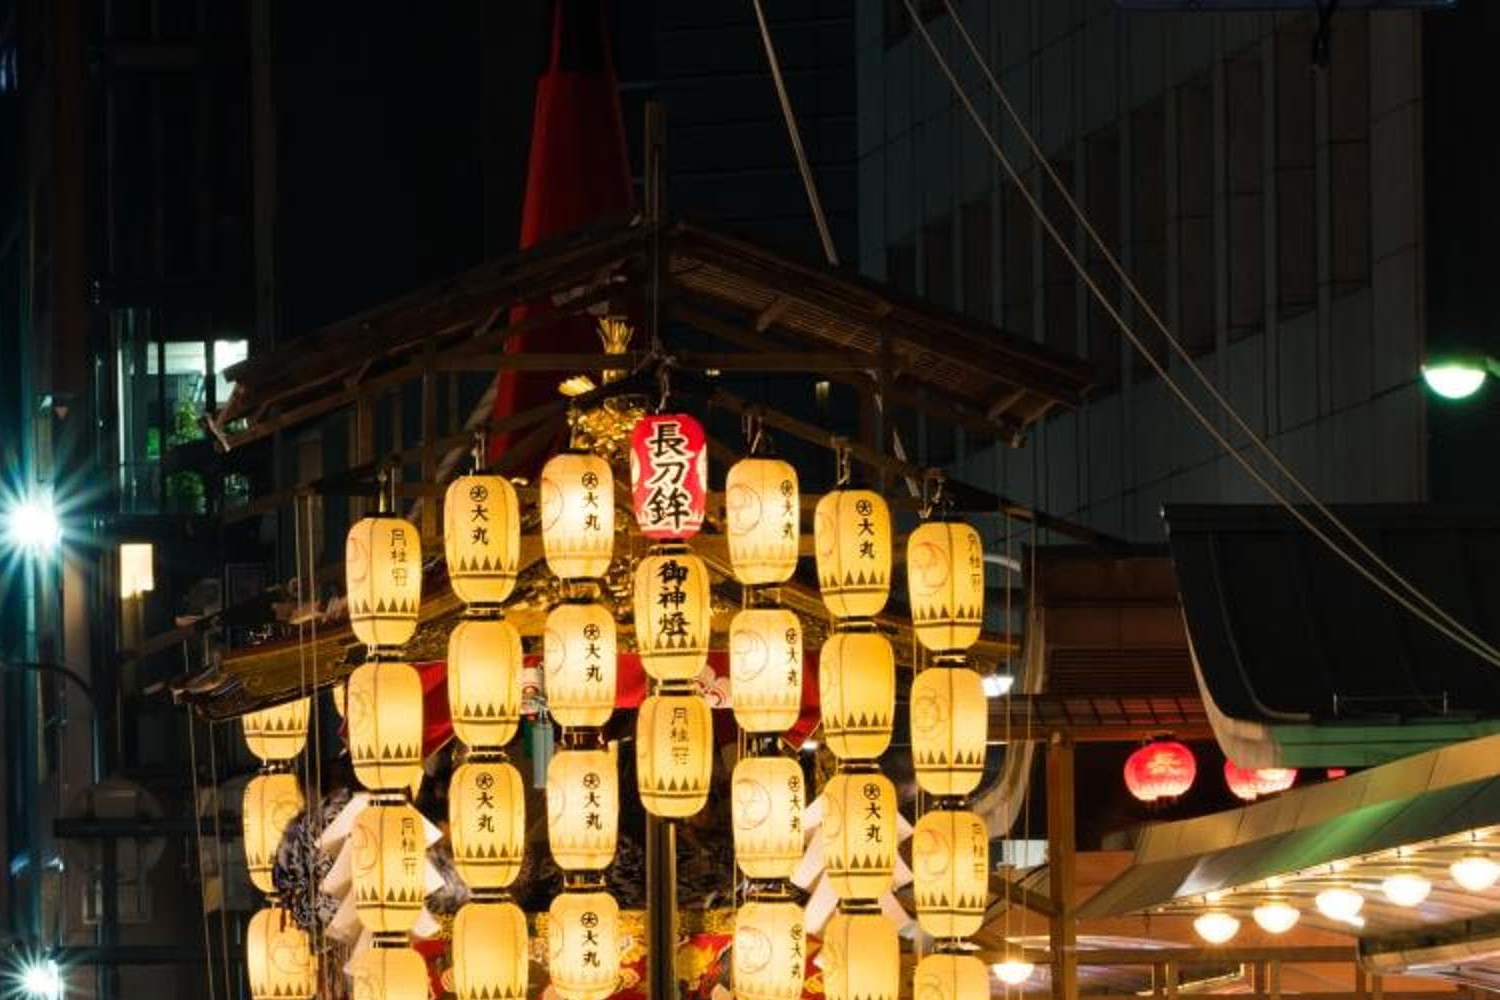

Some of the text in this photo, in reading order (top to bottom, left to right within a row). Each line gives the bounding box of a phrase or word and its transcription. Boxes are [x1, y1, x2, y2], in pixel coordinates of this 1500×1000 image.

[648, 423, 690, 529] 長刀鉾
[657, 561, 691, 638] 御神燈
